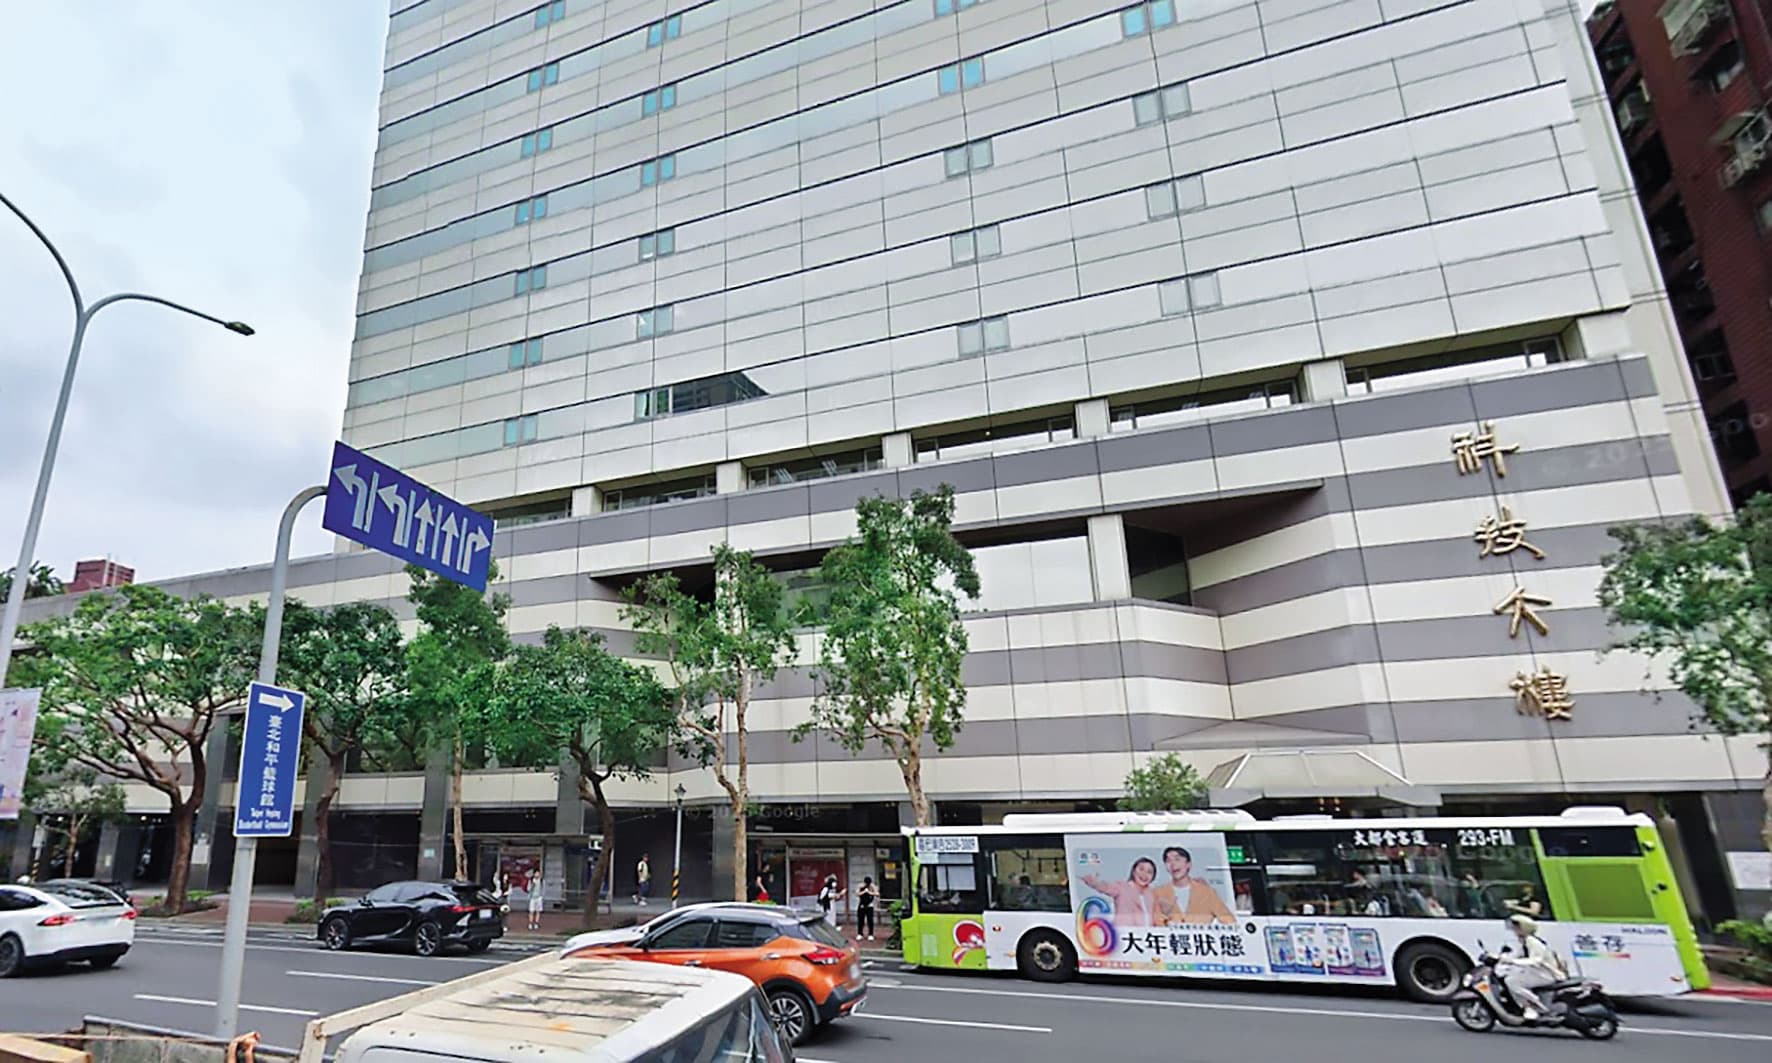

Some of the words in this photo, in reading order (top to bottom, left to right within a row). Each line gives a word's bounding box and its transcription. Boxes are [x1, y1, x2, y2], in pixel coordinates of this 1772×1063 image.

[1451, 421, 1575, 720] 科技大樓
[1354, 830, 1428, 847] 大都會客運
[1076, 896, 1117, 957] 6
[1122, 932, 1247, 957] 大年輕狀態
